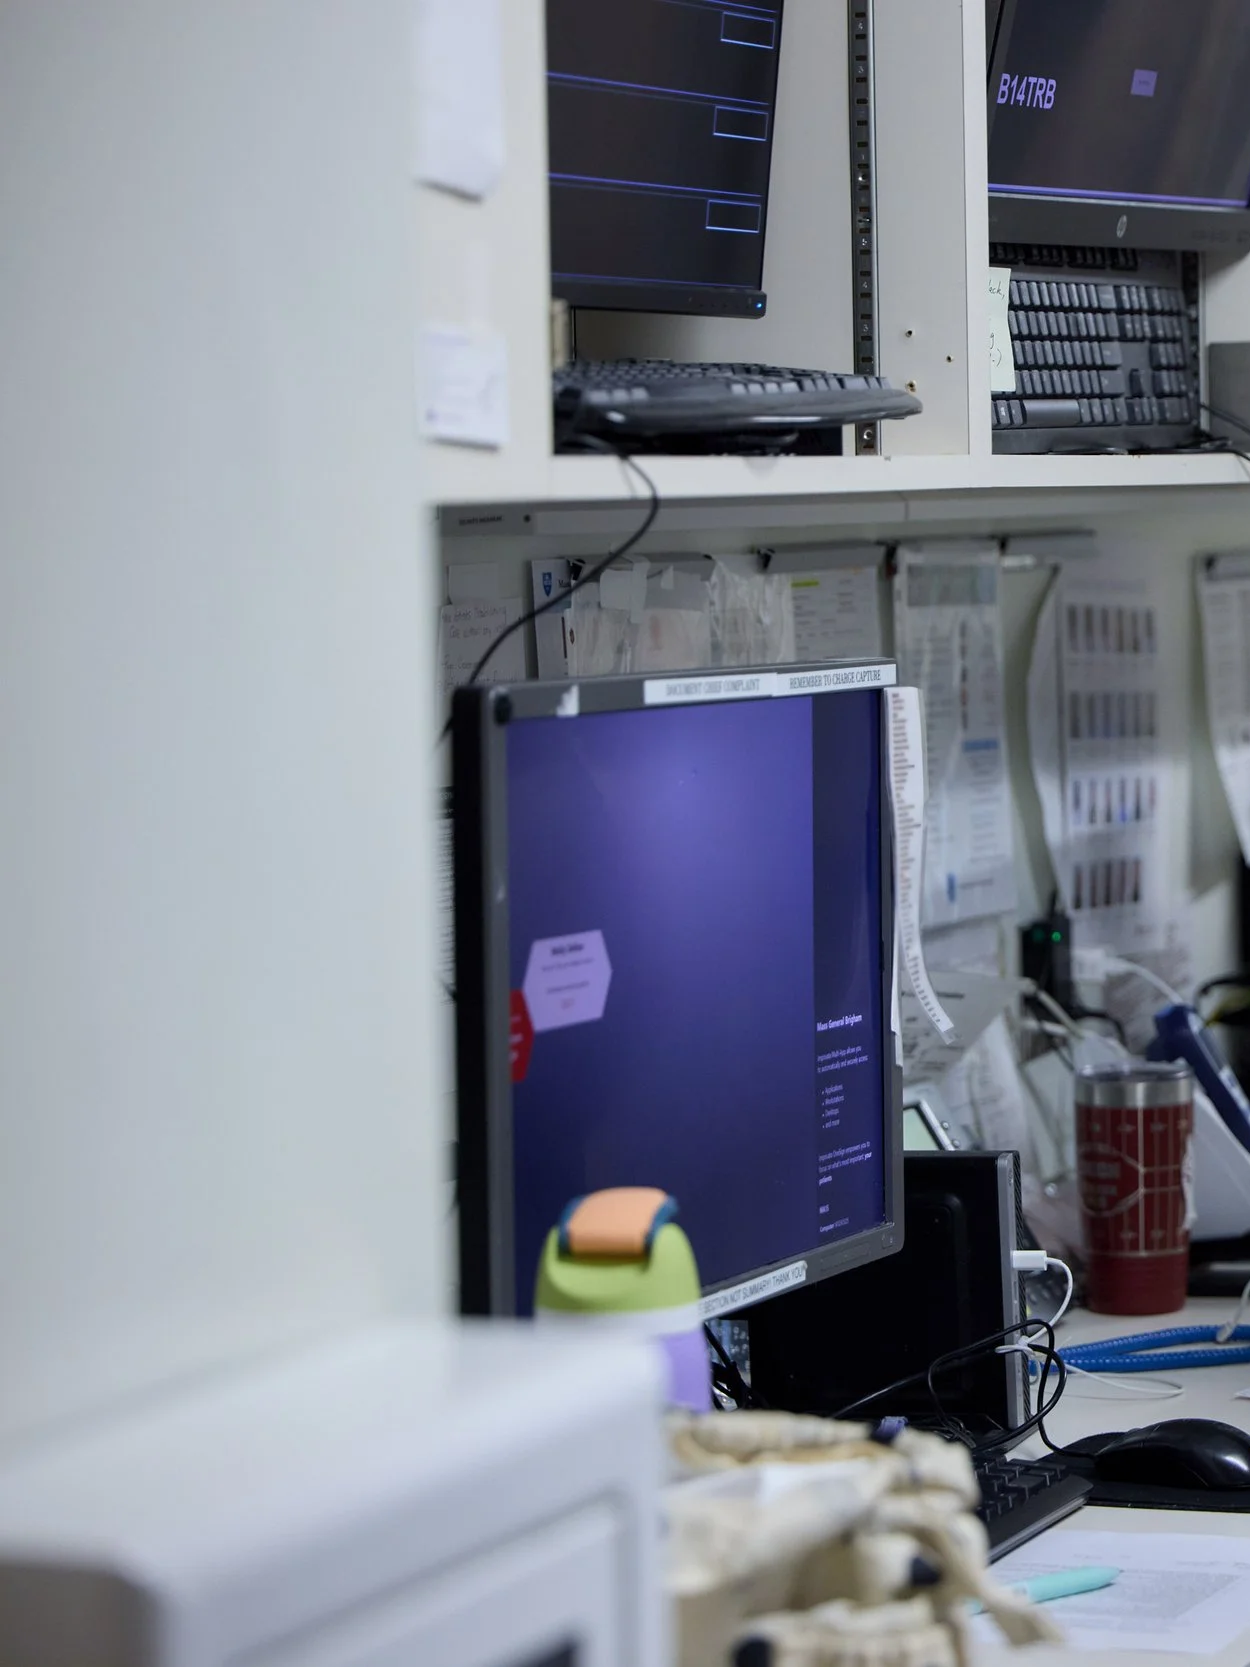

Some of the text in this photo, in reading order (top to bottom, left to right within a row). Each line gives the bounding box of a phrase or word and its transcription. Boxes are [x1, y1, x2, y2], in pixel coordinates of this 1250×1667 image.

[997, 73, 1057, 109] B14TRB
[723, 679, 760, 692] COMPLAINT
[789, 669, 881, 690] REMEMBER TO CHARGE CAPTURE
[816, 1013, 862, 1031] Mass General Brigham
[771, 1271, 790, 1286] THANK
